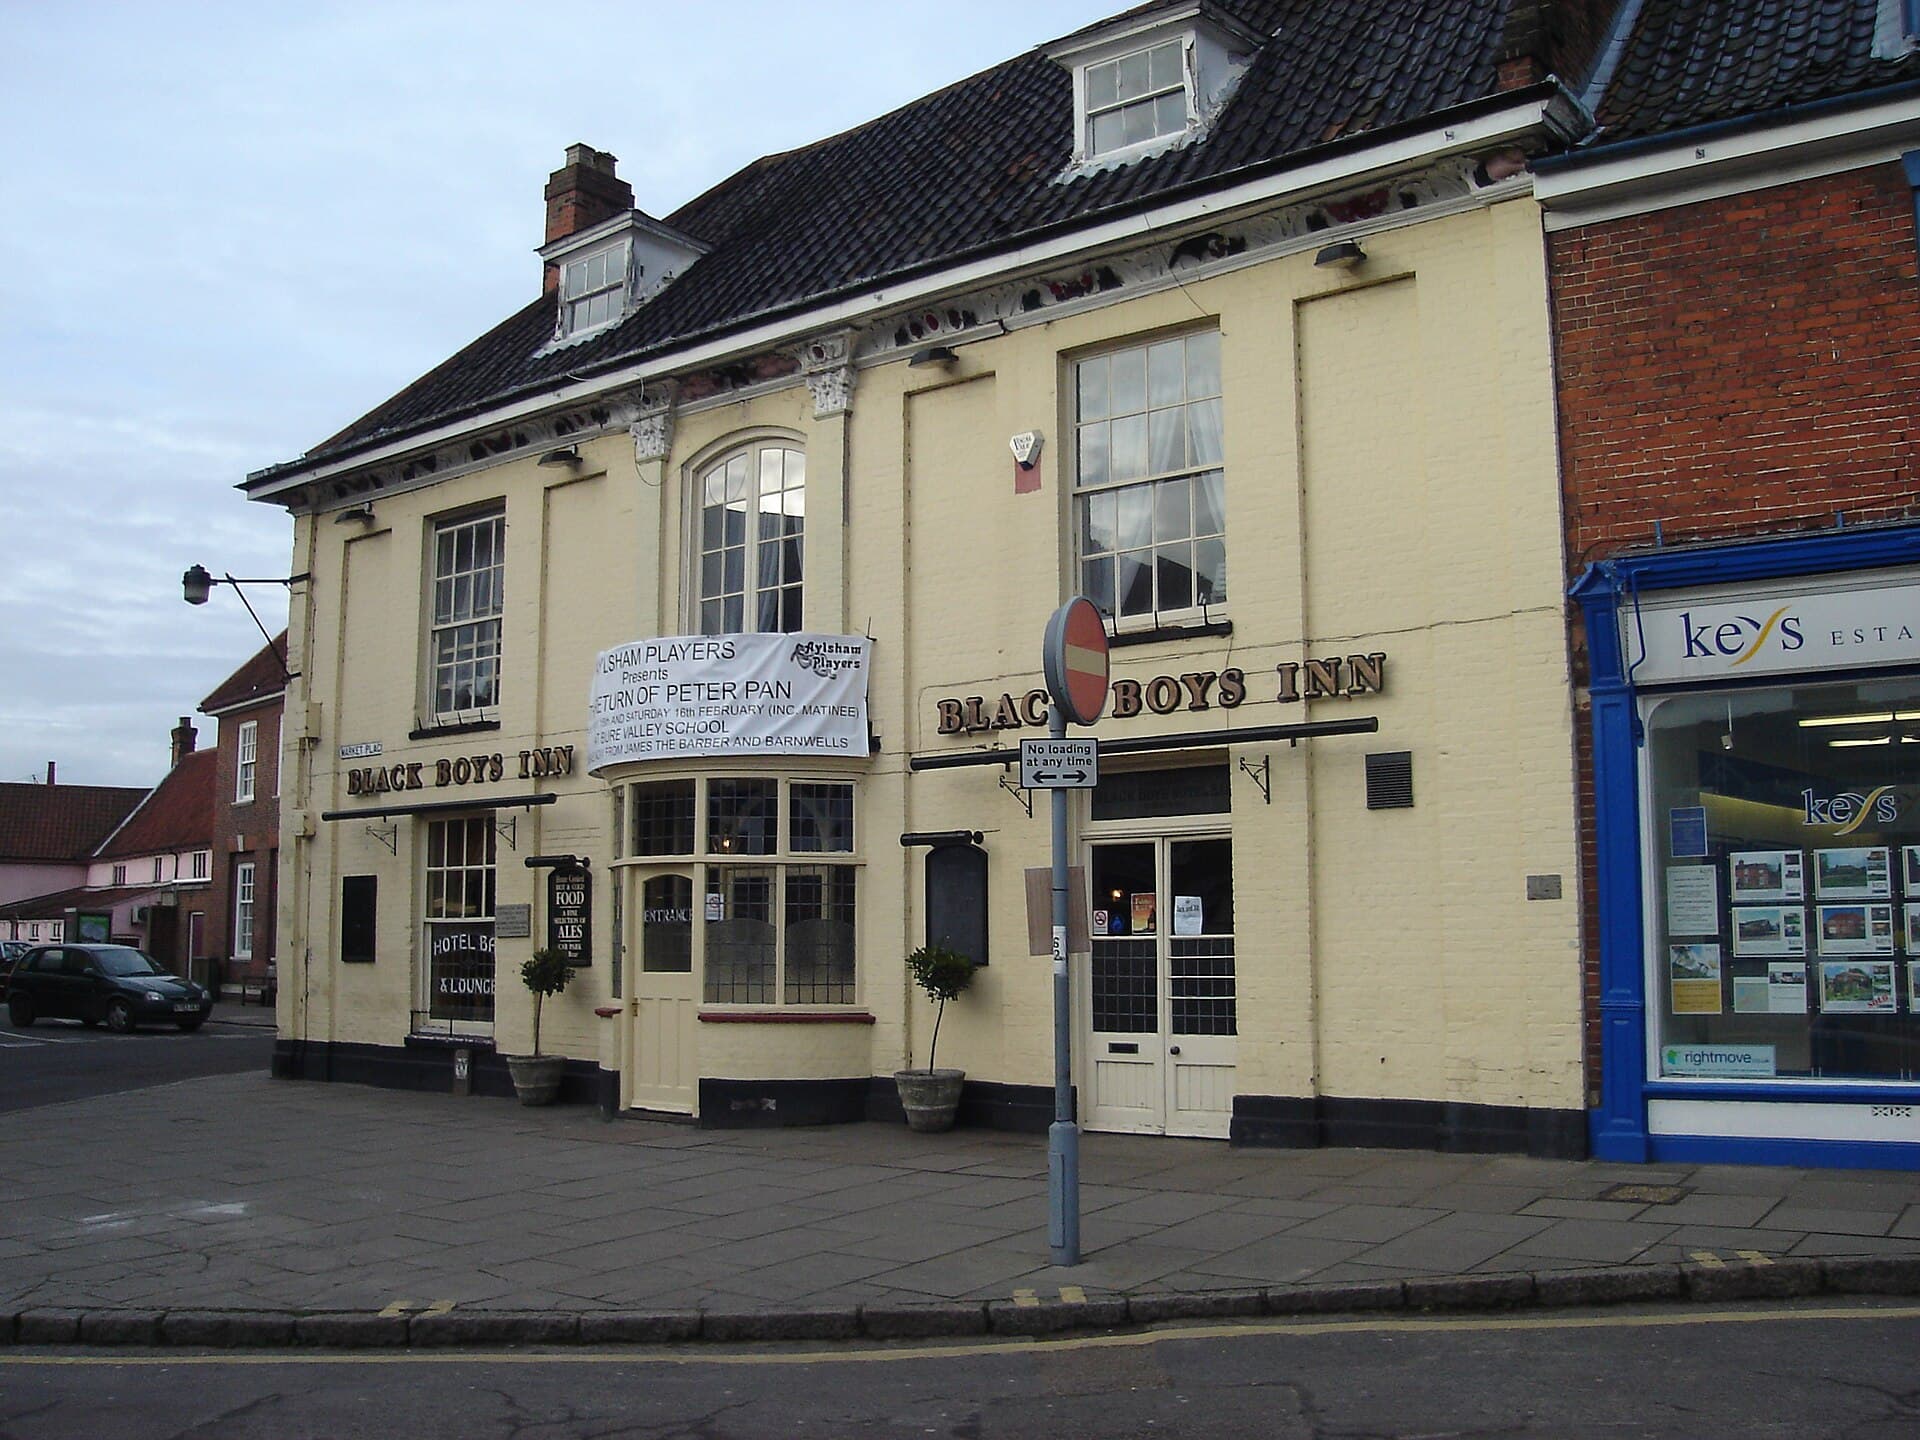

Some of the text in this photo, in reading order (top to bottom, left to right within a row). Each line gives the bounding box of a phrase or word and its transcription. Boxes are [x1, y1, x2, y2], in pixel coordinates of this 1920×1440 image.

[1680, 605, 1913, 667] keys ESTA
[645, 641, 735, 664] PLAYERS
[804, 641, 862, 655] Aylsham
[812, 657, 860, 670] Players
[622, 667, 669, 685] Presents
[637, 685, 660, 704] OF
[667, 682, 736, 702] PETER
[745, 680, 791, 699] PAN
[937, 652, 1387, 735] BLAC BOYS INN
[626, 708, 670, 722] SATURDAY
[676, 706, 695, 718] 16th
[699, 704, 764, 717] FEBRUARY
[802, 704, 860, 719] MATINEE)
[623, 722, 663, 739] VALLEY
[665, 719, 729, 735] SCHOOL
[624, 740, 652, 754] JAMES
[656, 739, 675, 750] THE
[679, 737, 730, 750] BARBER
[733, 736, 761, 747] AND
[765, 736, 849, 749] BARNWELLS
[1028, 743, 1091, 756] No loading
[347, 745, 574, 795] BLACK BOYS INN
[1026, 756, 1093, 768] at any time
[1801, 785, 1896, 836] keys
[556, 891, 585, 905] FOOD
[644, 908, 693, 923] ENTRANCE
[558, 925, 583, 939] ALES
[433, 933, 496, 956] HOTEL BA
[440, 977, 496, 994] & LOUNGE
[1684, 1050, 1752, 1066] rightmove
